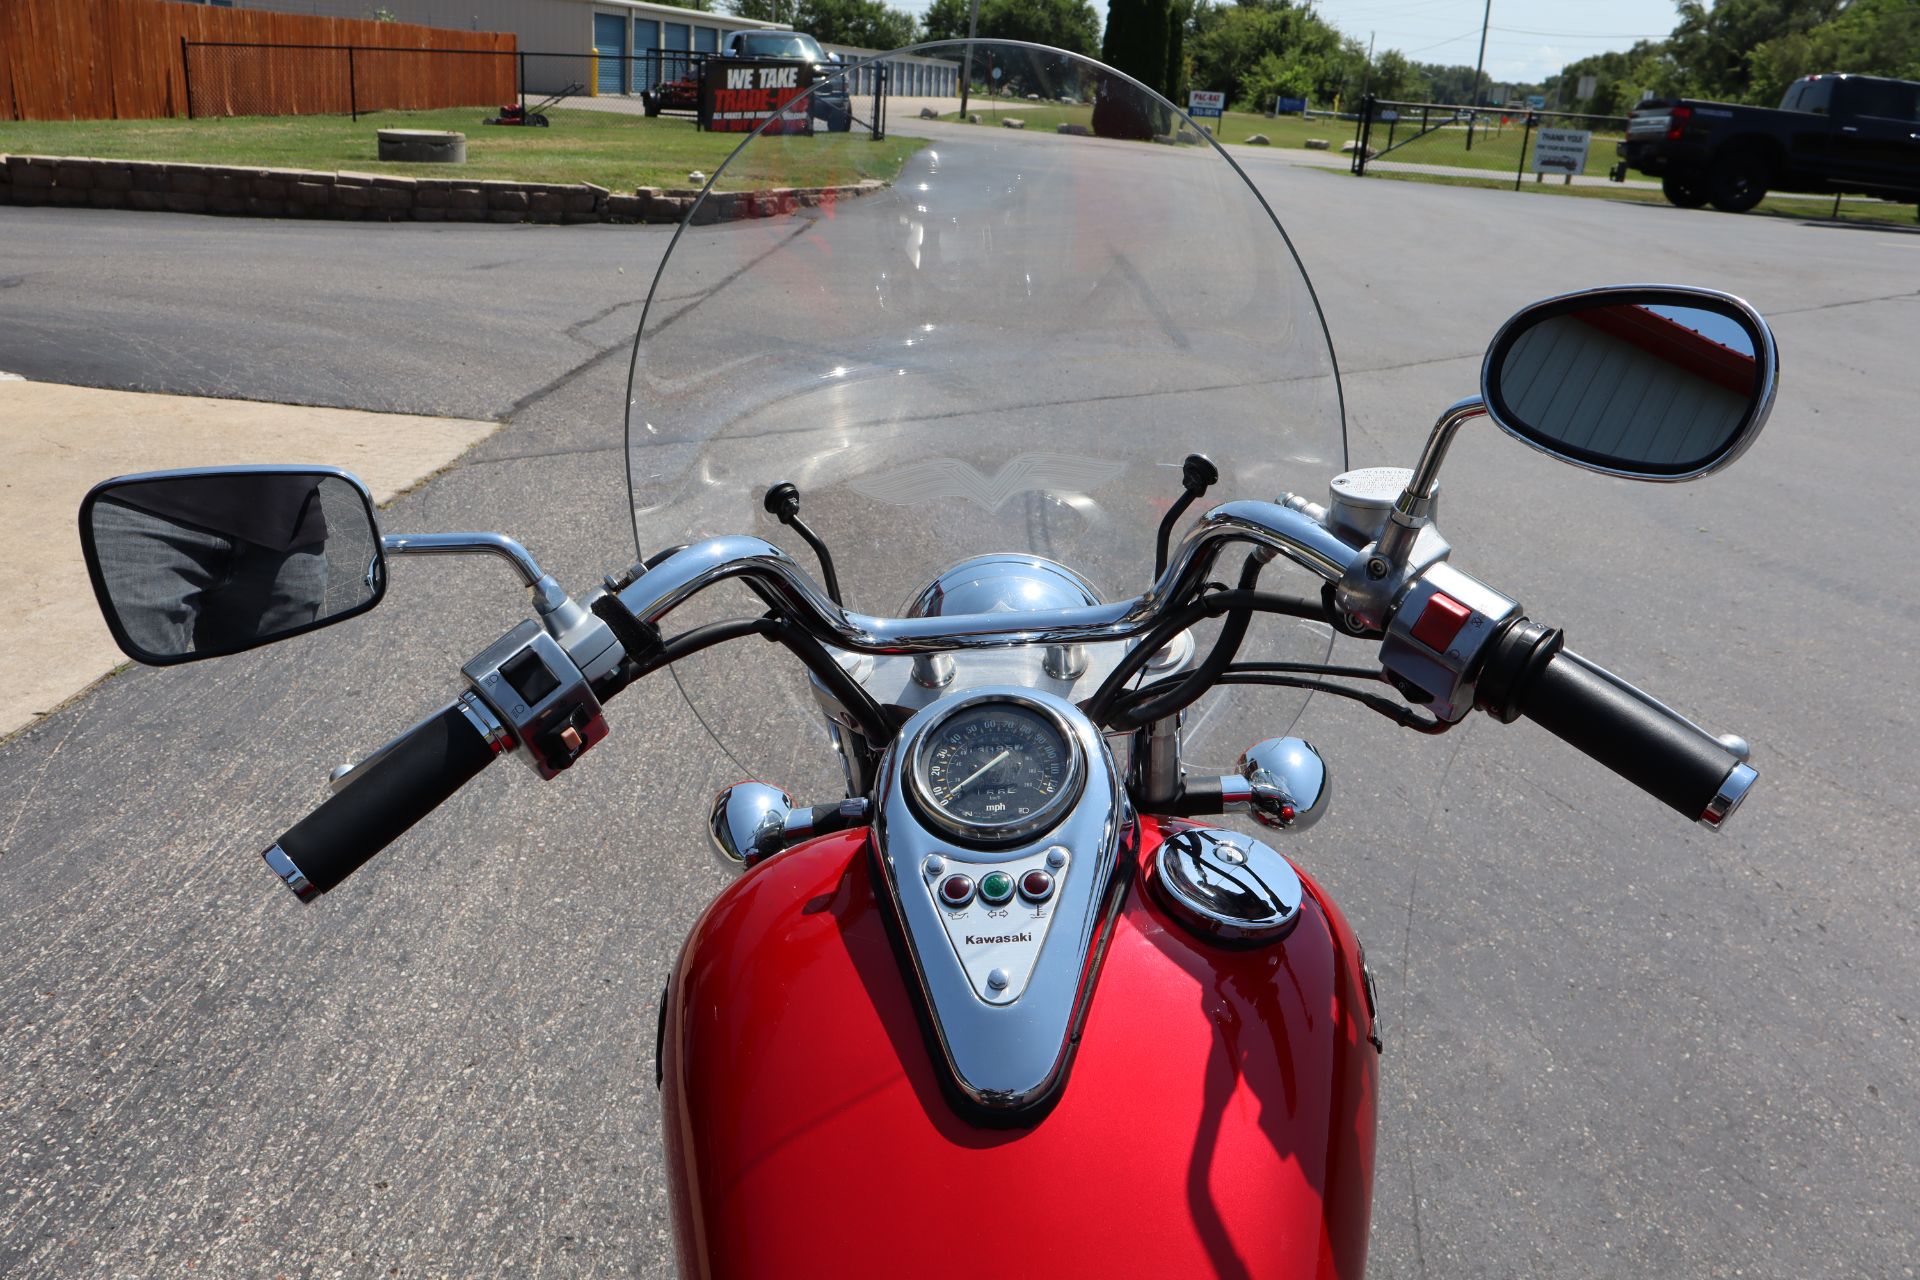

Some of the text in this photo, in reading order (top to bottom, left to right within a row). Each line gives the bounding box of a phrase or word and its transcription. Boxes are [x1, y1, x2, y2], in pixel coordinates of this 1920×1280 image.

[727, 67, 799, 89] WE TAKE
[1542, 132, 1565, 141] THANK
[966, 724, 978, 734] 50
[984, 720, 996, 728] 60
[1002, 720, 1015, 729] 70
[950, 733, 961, 744] 40
[1035, 734, 1046, 744] 90
[936, 748, 948, 759] 30
[1044, 745, 1057, 759] 100
[931, 766, 941, 776] 20
[1050, 763, 1060, 775] 110
[932, 786, 944, 795] 10
[986, 802, 1006, 812] mph
[965, 932, 1032, 945] Kawasaki
